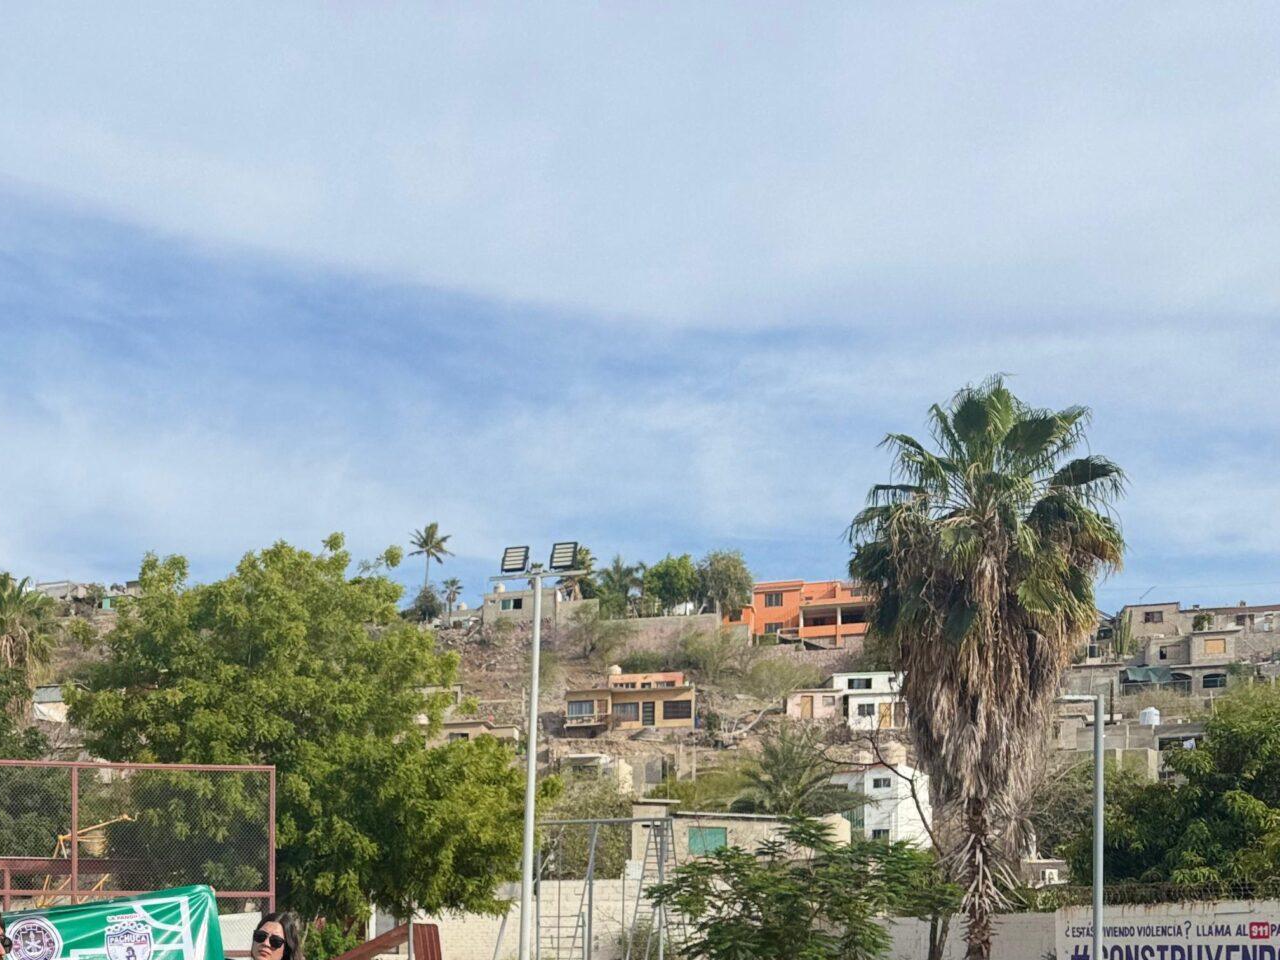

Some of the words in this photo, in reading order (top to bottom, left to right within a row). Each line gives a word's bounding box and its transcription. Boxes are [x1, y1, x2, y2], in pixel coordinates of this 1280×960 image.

[1102, 926, 1135, 937] IVIENDO
[1236, 924, 1248, 936] AL
[1251, 925, 1269, 937] 911
